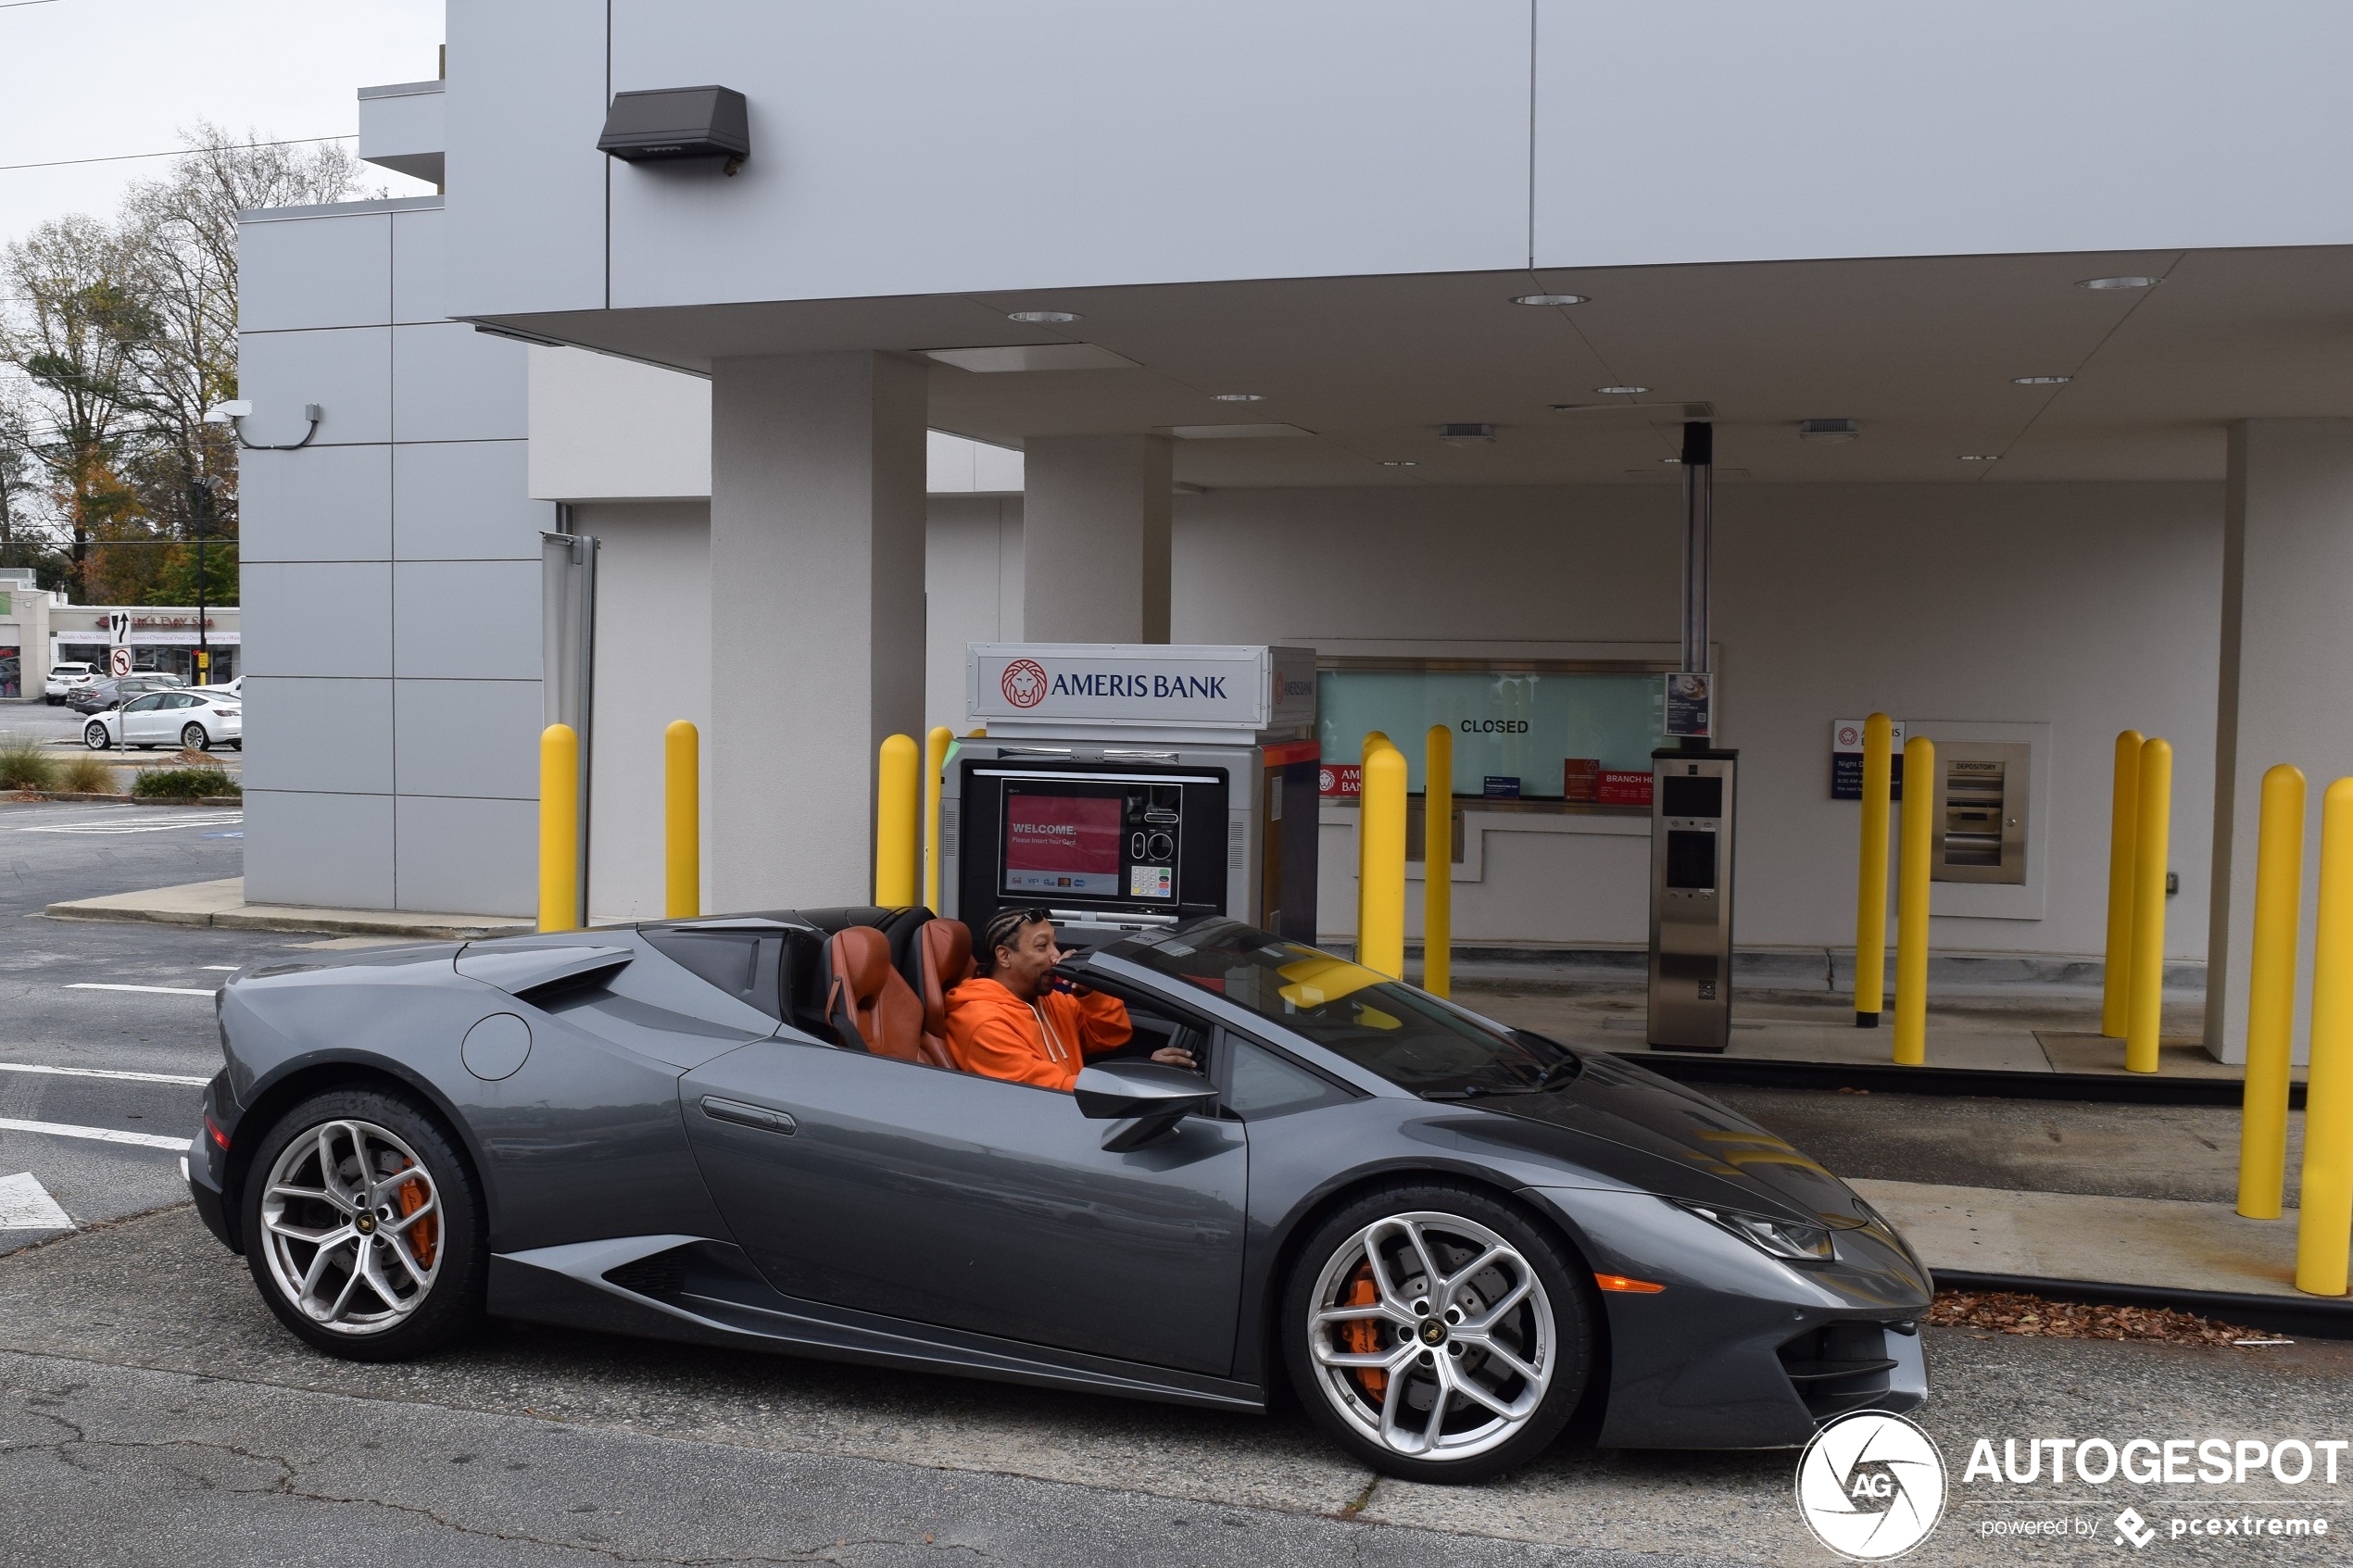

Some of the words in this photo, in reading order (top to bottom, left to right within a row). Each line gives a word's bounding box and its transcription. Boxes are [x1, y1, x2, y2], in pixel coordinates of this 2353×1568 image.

[1051, 673, 1148, 697] AMERIS
[1153, 675, 1227, 699] BANK
[1461, 720, 1529, 734] CLOSED
[1838, 760, 1857, 769] Night
[1606, 774, 1642, 784] BRANCH
[1013, 823, 1077, 835] WELCOME.
